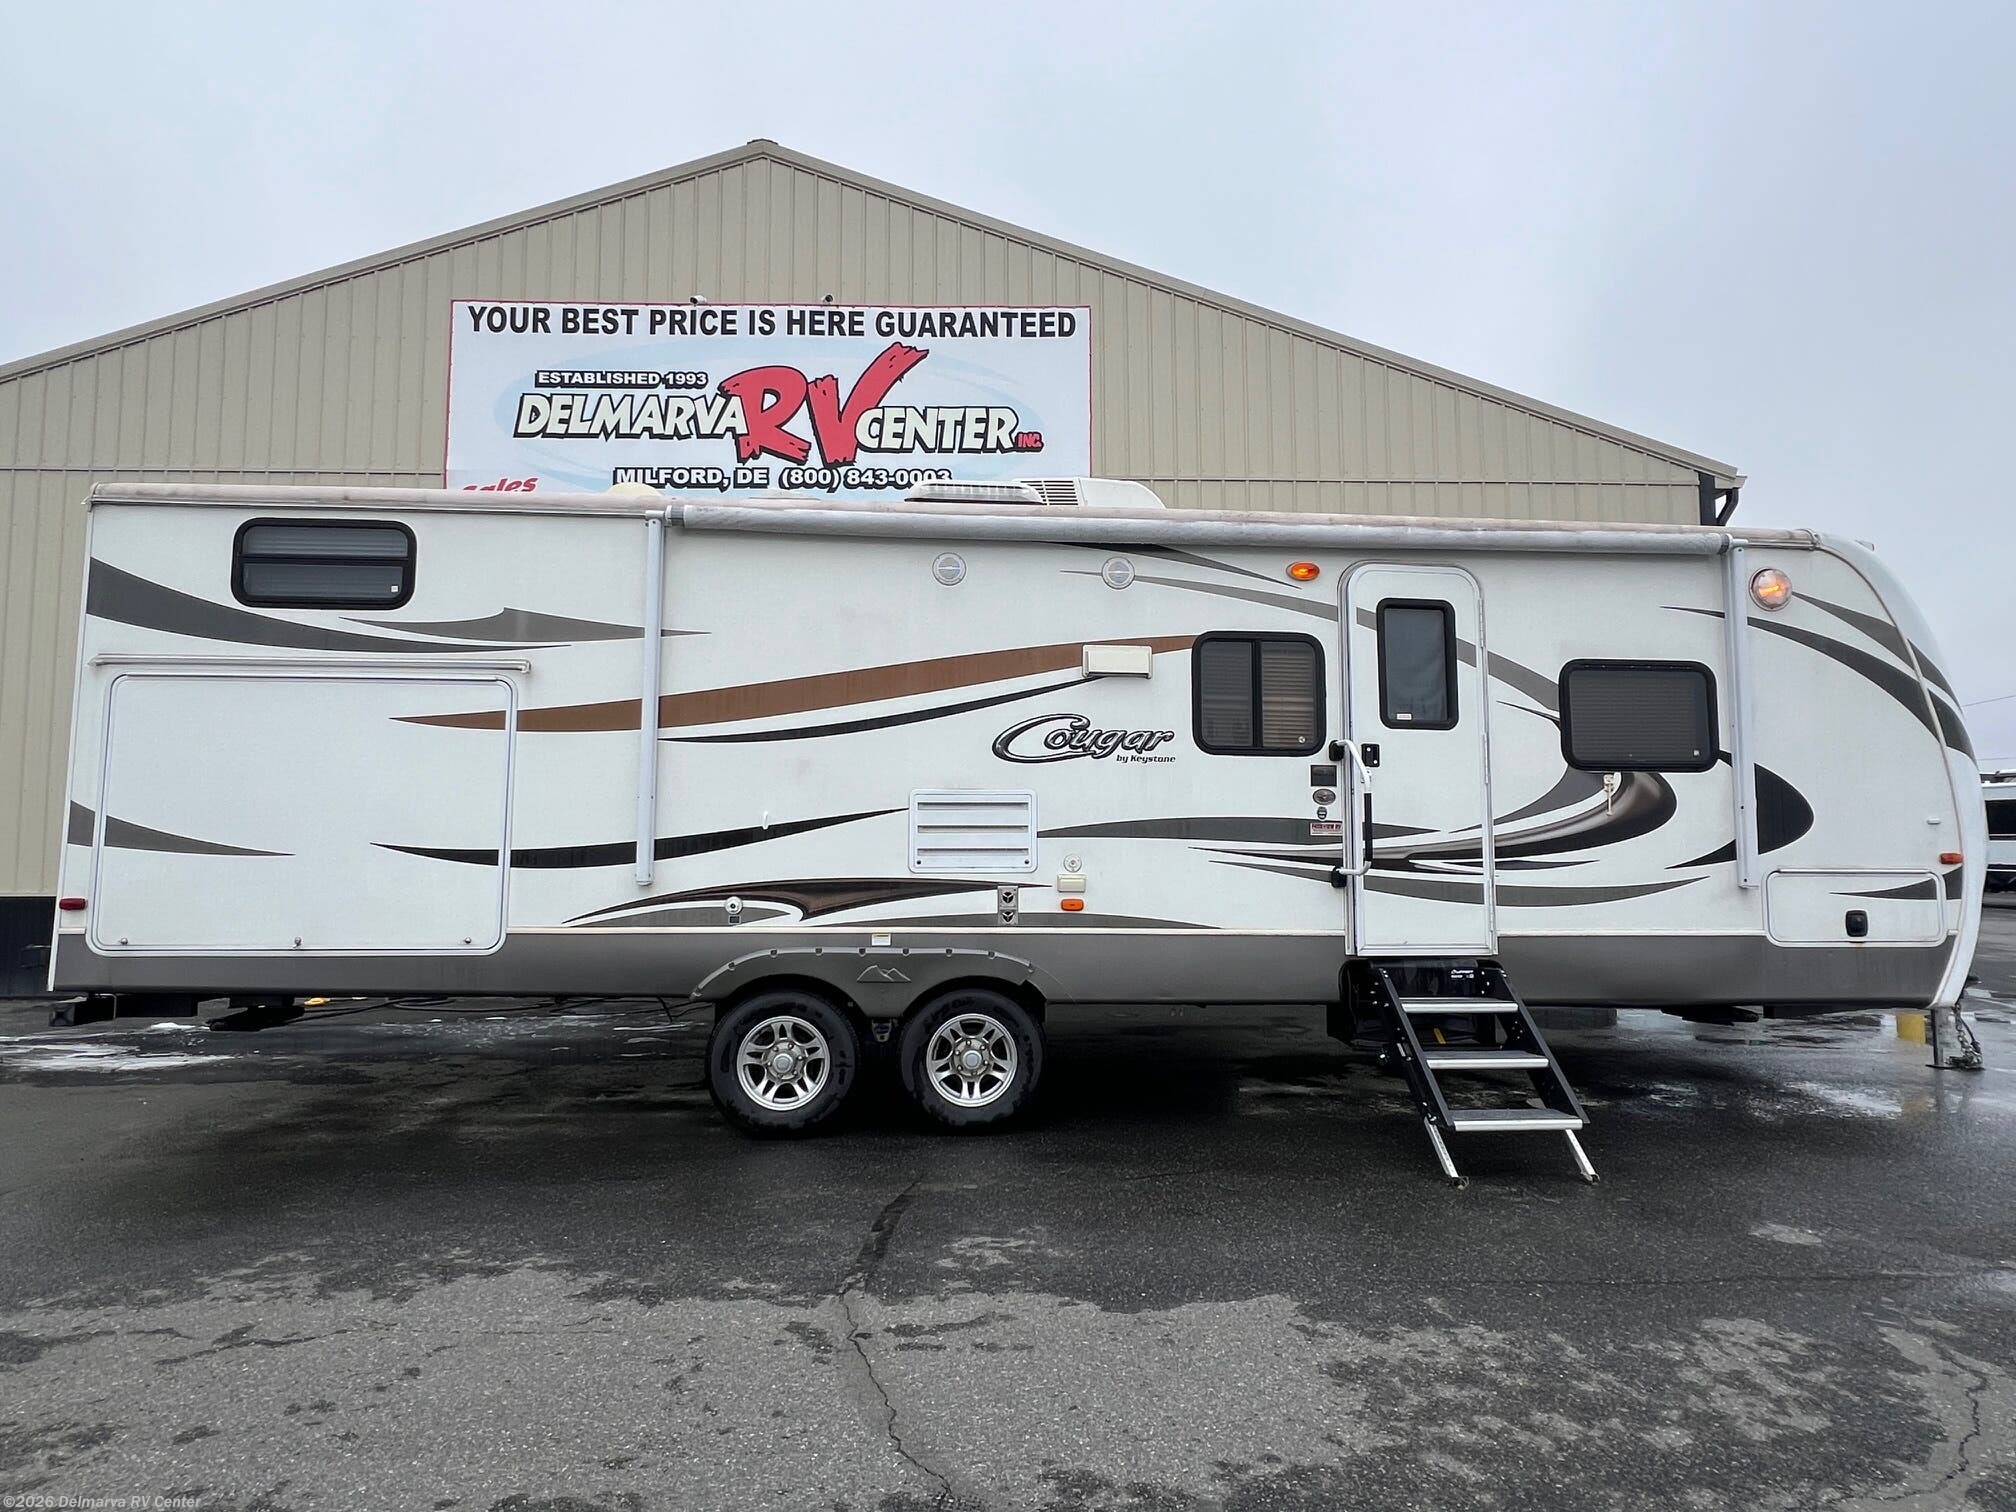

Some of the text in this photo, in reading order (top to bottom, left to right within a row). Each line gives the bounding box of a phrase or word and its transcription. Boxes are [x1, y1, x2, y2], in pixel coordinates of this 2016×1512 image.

[468, 306, 1076, 338] YOUR BEST PRICE IS HERE GUARANTEED
[537, 371, 708, 386] ESTABLISHED 1993
[515, 342, 1043, 466] DELMARVA RV CENTER INC.
[615, 467, 951, 489] MILFORD, DE (800) 843-0003
[992, 713, 1175, 764] Cougar
[1116, 755, 1176, 764] by Keystone
